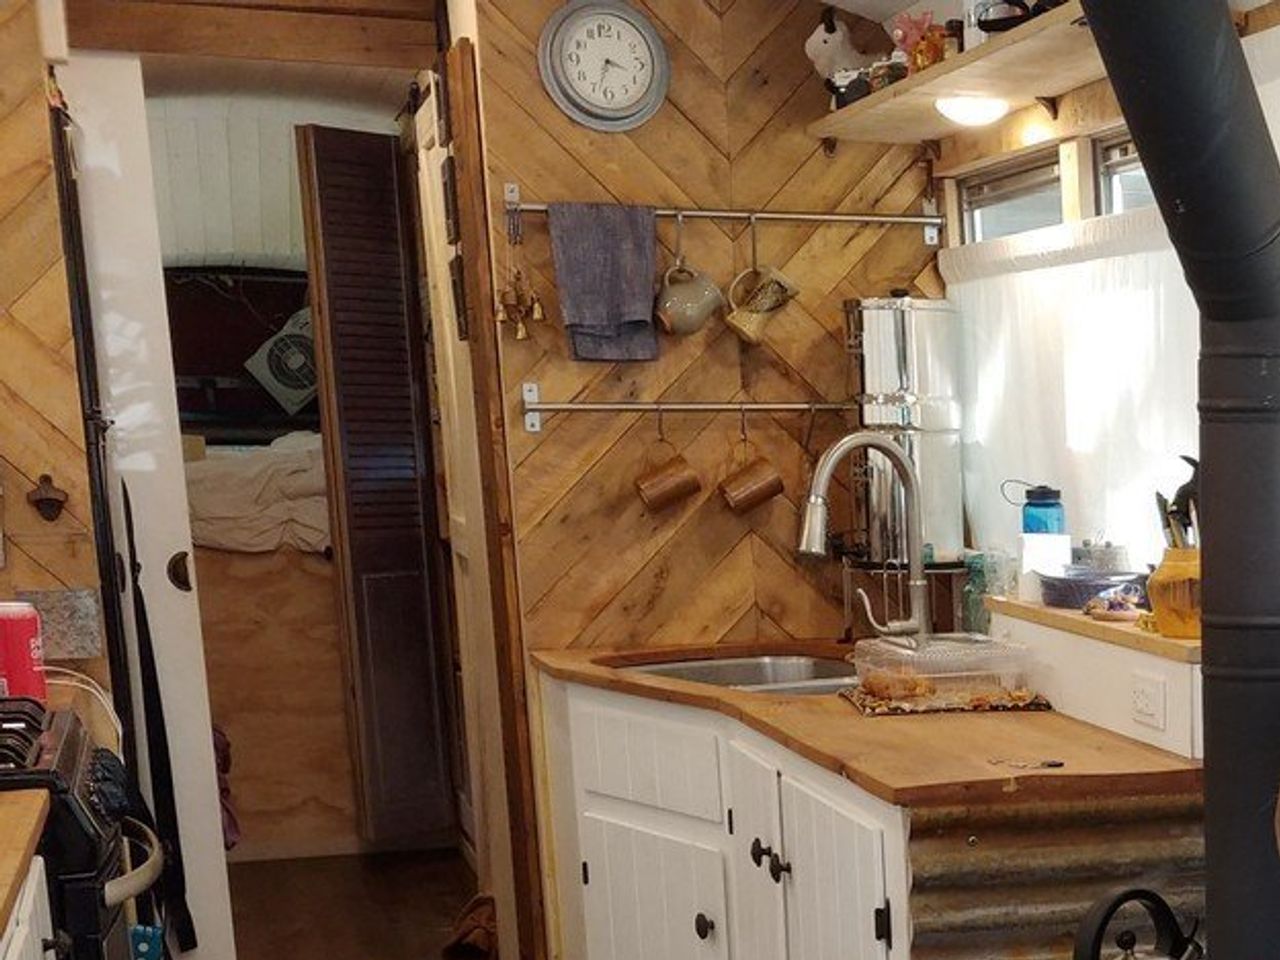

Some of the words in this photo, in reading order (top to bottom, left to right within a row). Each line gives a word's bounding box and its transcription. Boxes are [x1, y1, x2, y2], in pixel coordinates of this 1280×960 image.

[597, 22, 612, 38] 12
[567, 51, 580, 66] 9
[590, 81, 598, 93] 7
[602, 87, 615, 100] 6
